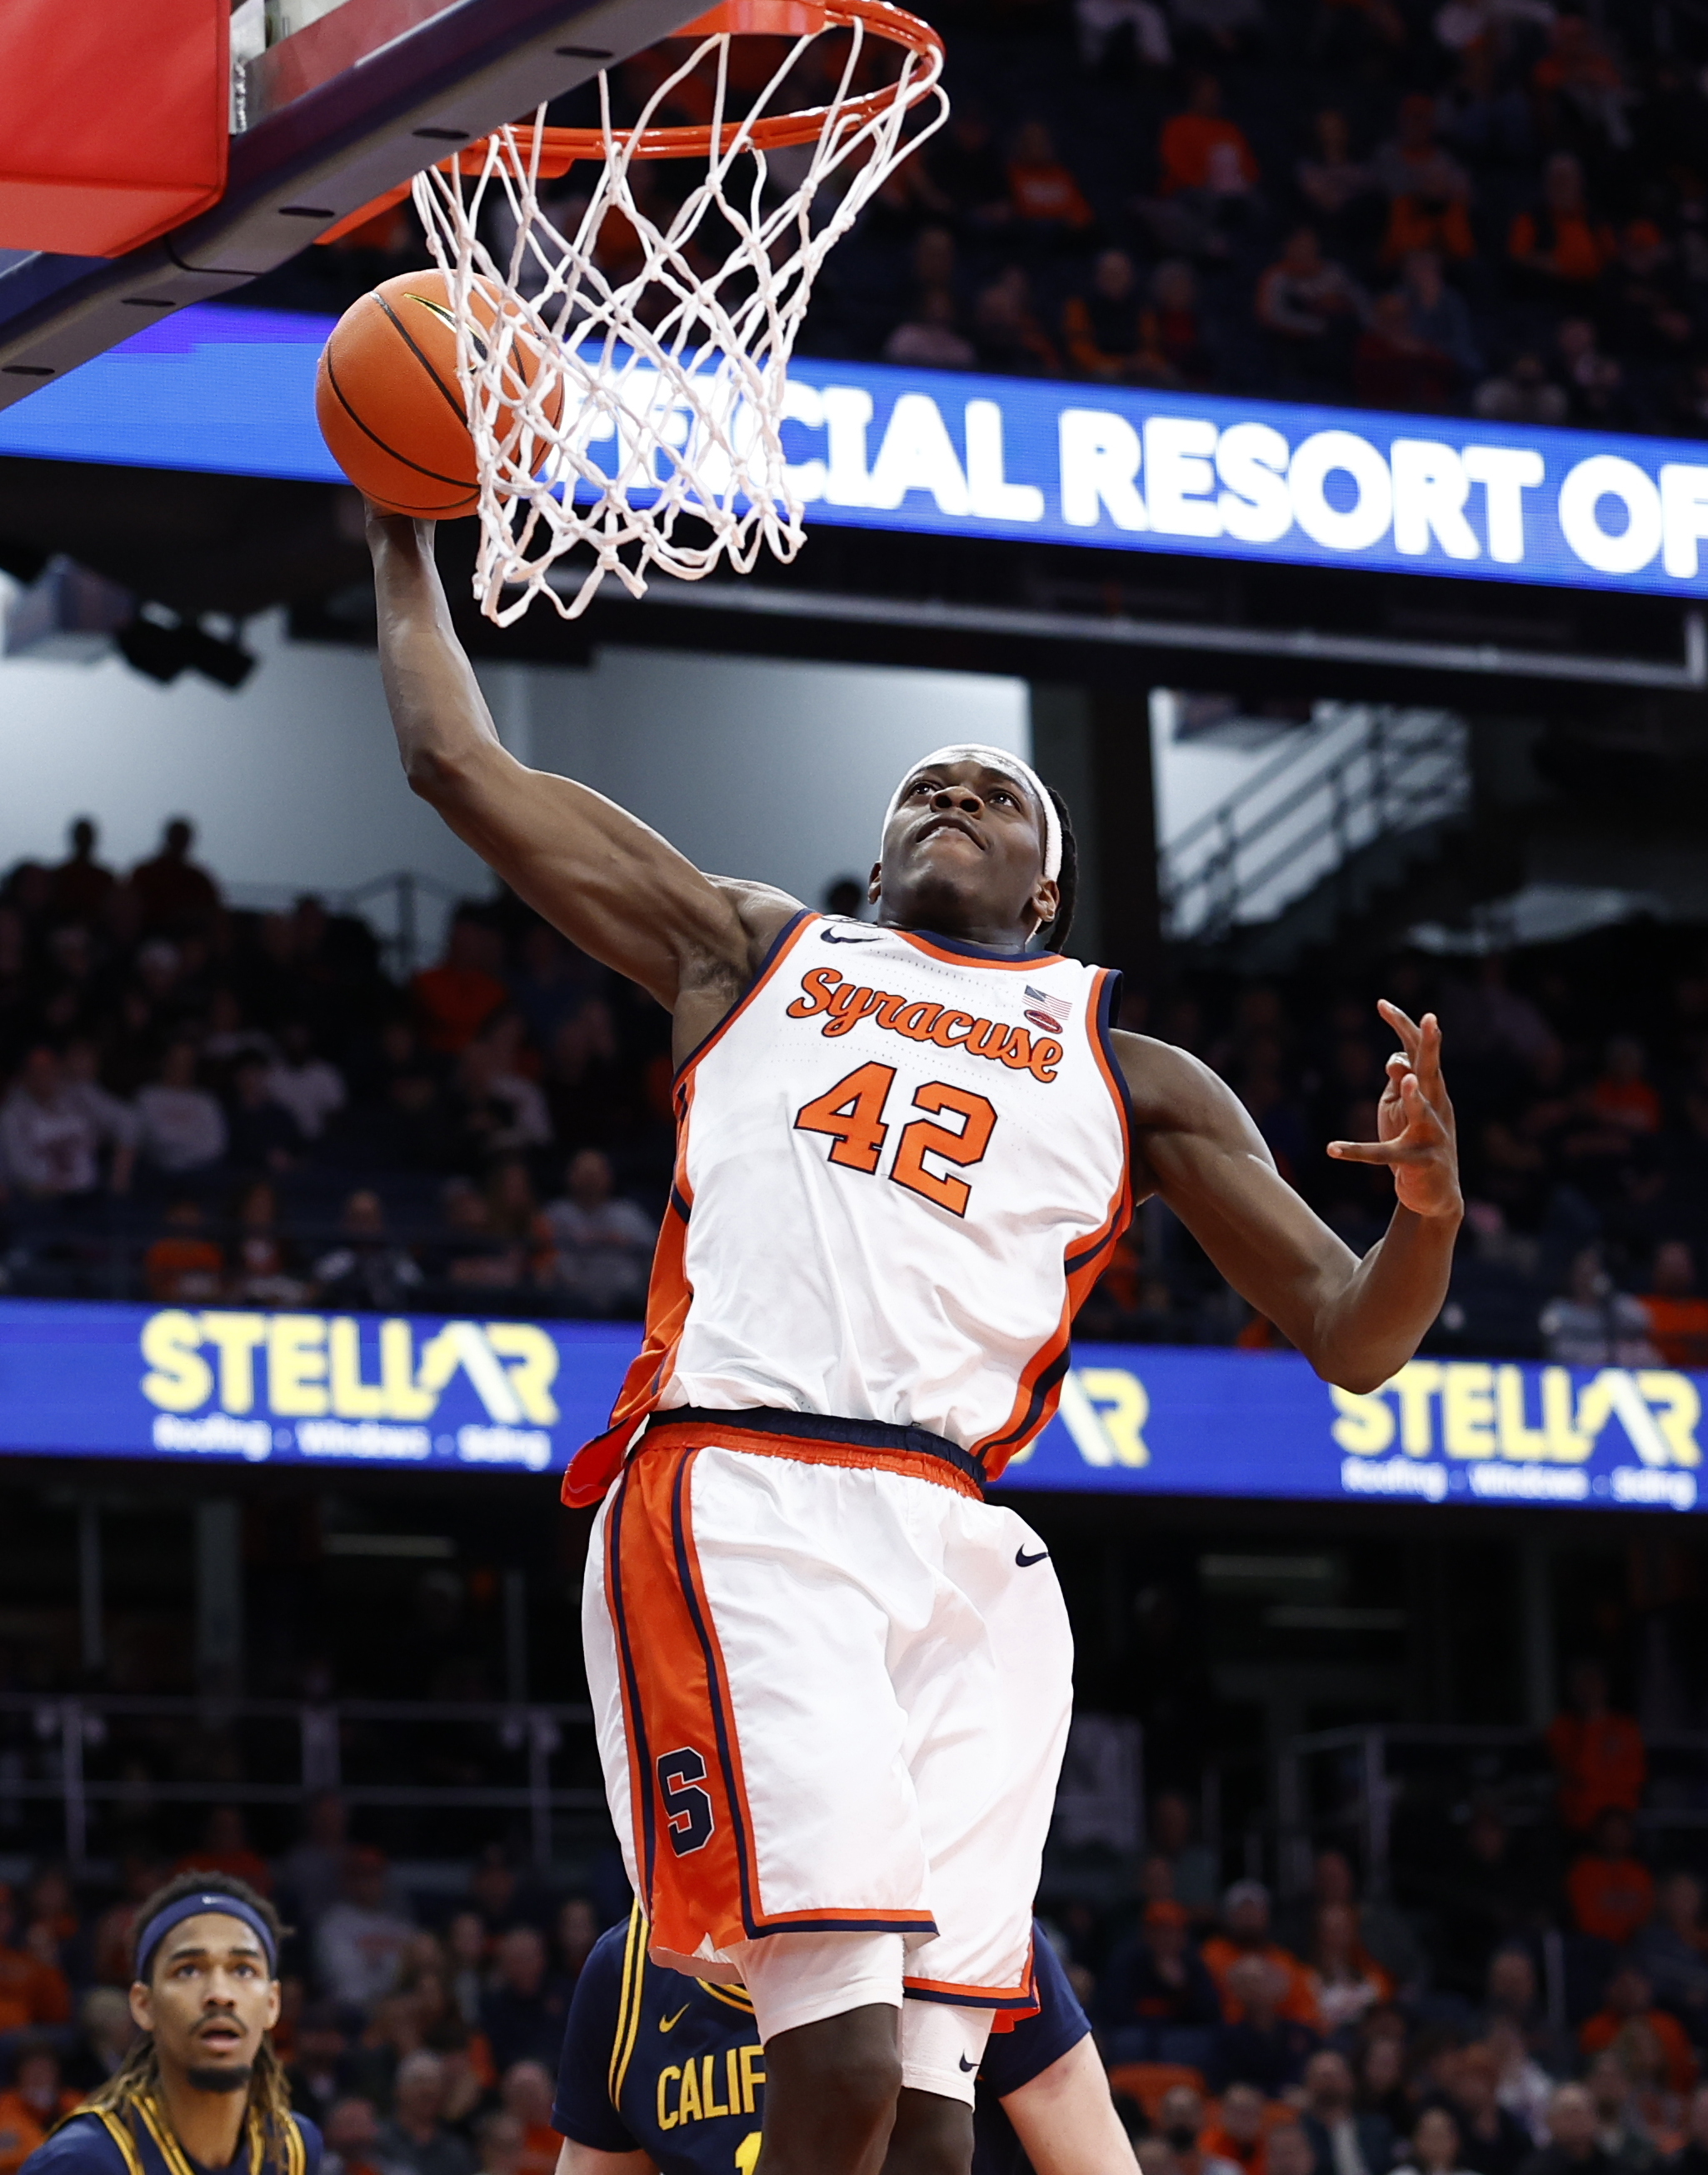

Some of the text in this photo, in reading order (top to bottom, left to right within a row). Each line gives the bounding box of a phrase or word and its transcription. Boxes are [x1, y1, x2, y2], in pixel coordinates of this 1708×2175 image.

[543, 363, 1708, 578] FFICIAL RESORT OF
[786, 967, 1063, 1083] Syracuse
[793, 1060, 998, 1218] 42
[142, 1310, 558, 1425] STELLAR
[1331, 1359, 1701, 1468] STELLAR
[657, 1746, 715, 1858] S
[657, 2045, 767, 2131] CALIF
